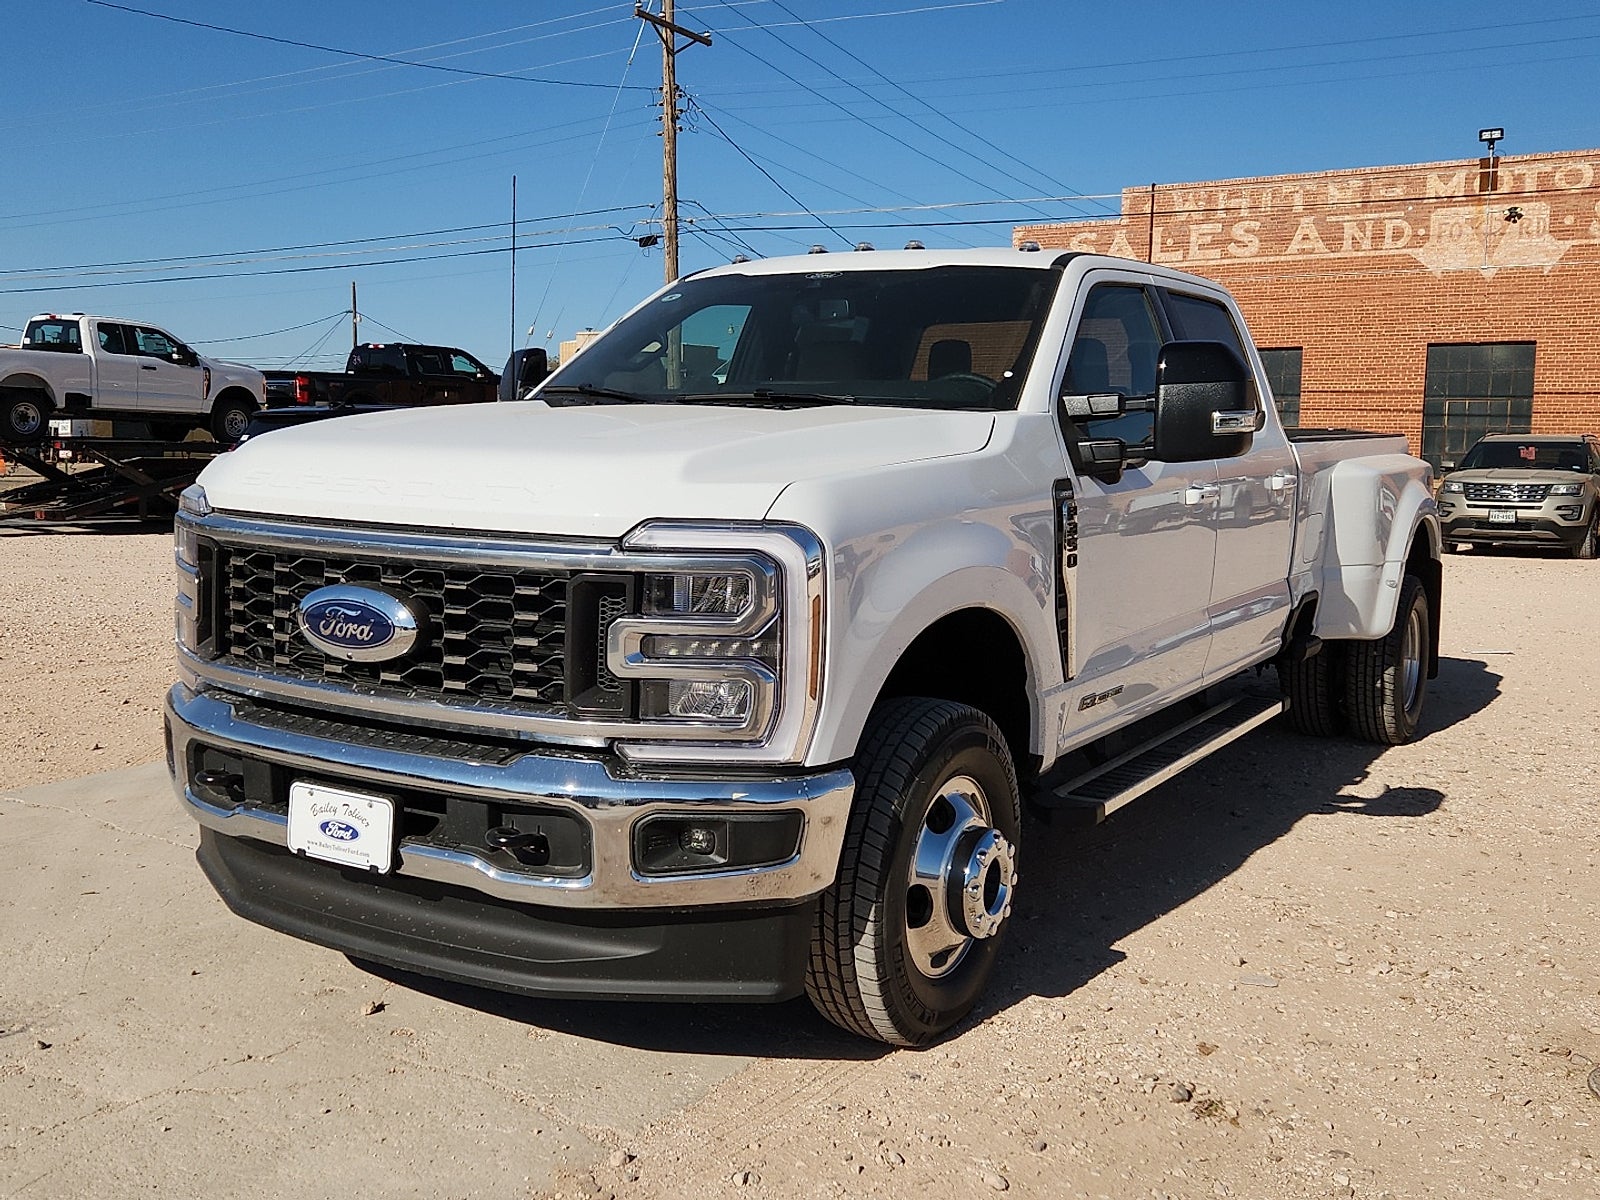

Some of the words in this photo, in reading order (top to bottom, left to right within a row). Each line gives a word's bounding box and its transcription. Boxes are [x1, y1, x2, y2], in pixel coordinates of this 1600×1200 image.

[1069, 220, 1261, 264] SALES
[1286, 214, 1413, 258] AND
[320, 606, 374, 641] Ford
[310, 802, 338, 817] Bailey
[325, 820, 353, 840] Ford
